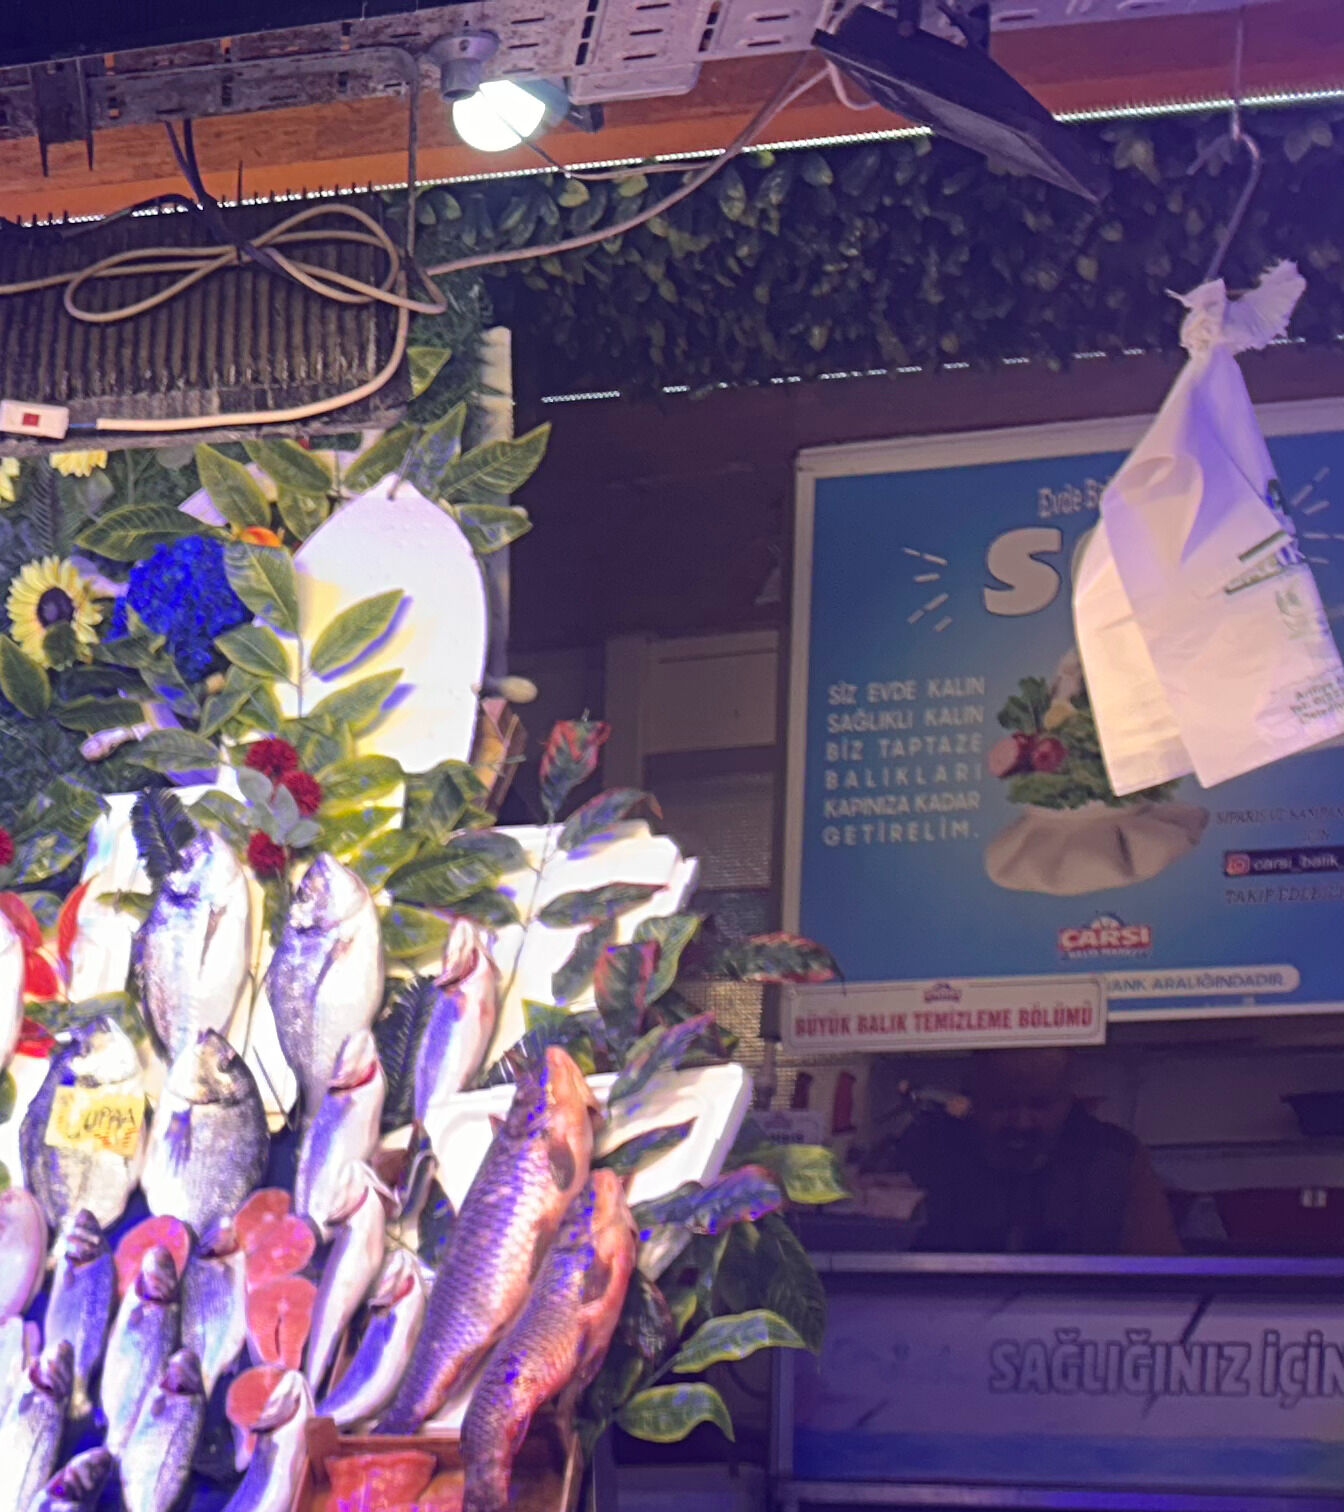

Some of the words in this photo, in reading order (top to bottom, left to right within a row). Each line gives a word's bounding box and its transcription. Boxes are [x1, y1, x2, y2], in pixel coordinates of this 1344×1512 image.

[867, 680, 916, 703] EVDE
[928, 676, 985, 698] KALIN
[827, 708, 912, 733] SAĞLIKLI
[925, 705, 984, 727] KALIN
[826, 737, 863, 762] BİZ
[878, 733, 982, 758] TAPTAZE
[825, 763, 982, 790] BALIKLARI
[914, 791, 980, 813] KADAR
[857, 1012, 907, 1036] BALIK
[913, 1006, 1012, 1034] TEMİZLEME
[1018, 1002, 1093, 1029] BÖLÜMÜ
[988, 1327, 1251, 1398] SAĞLIĞINIZ
